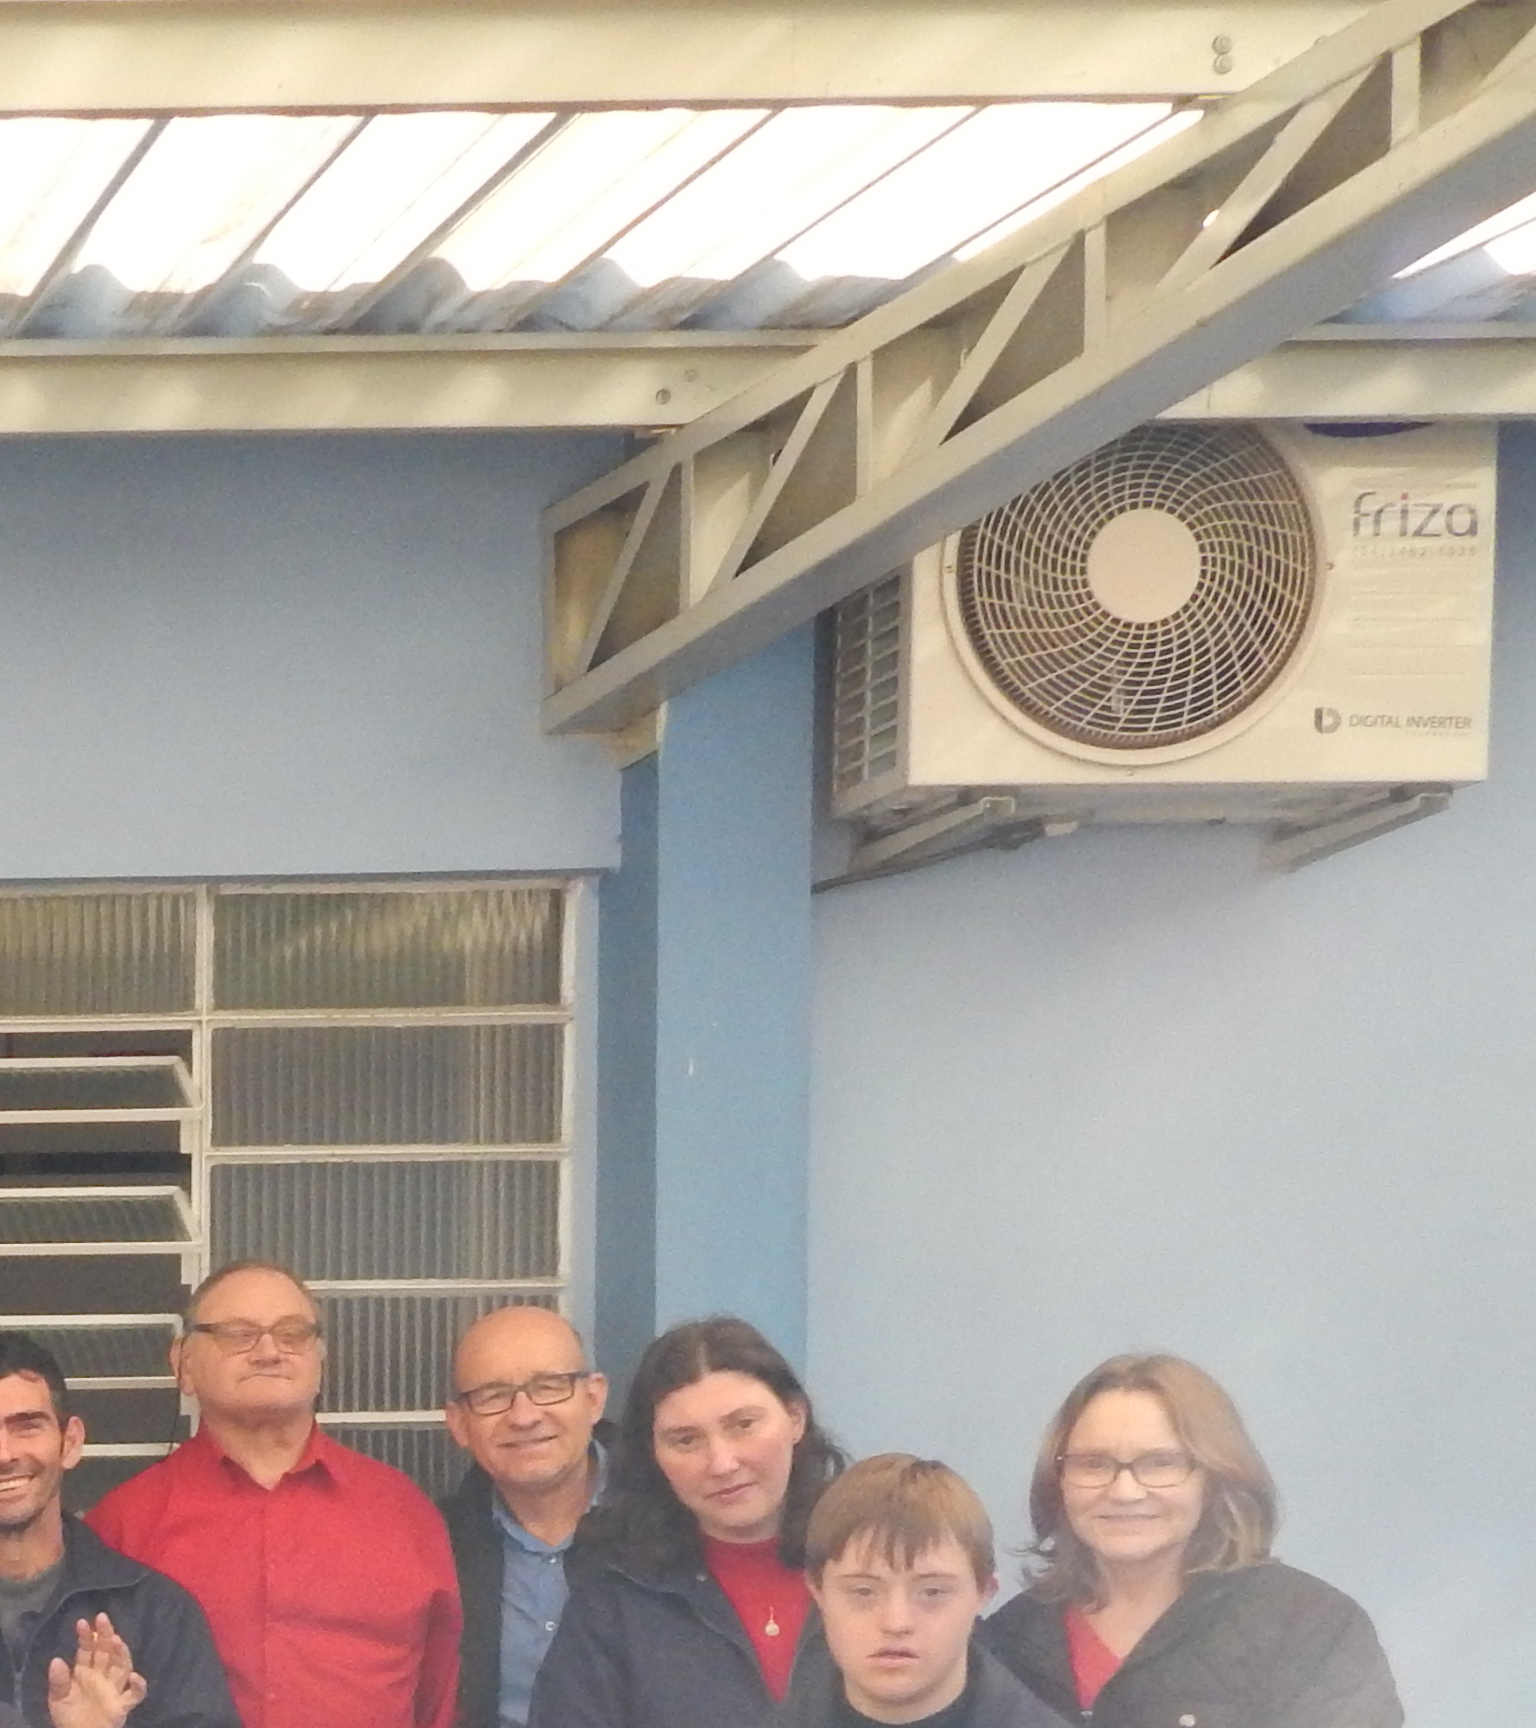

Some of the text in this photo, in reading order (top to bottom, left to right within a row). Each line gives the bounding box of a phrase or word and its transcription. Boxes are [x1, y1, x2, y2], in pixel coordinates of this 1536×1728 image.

[1352, 491, 1478, 538] friza
[1349, 714, 1401, 728] DIGITAL
[1406, 715, 1472, 730] INVERTER
